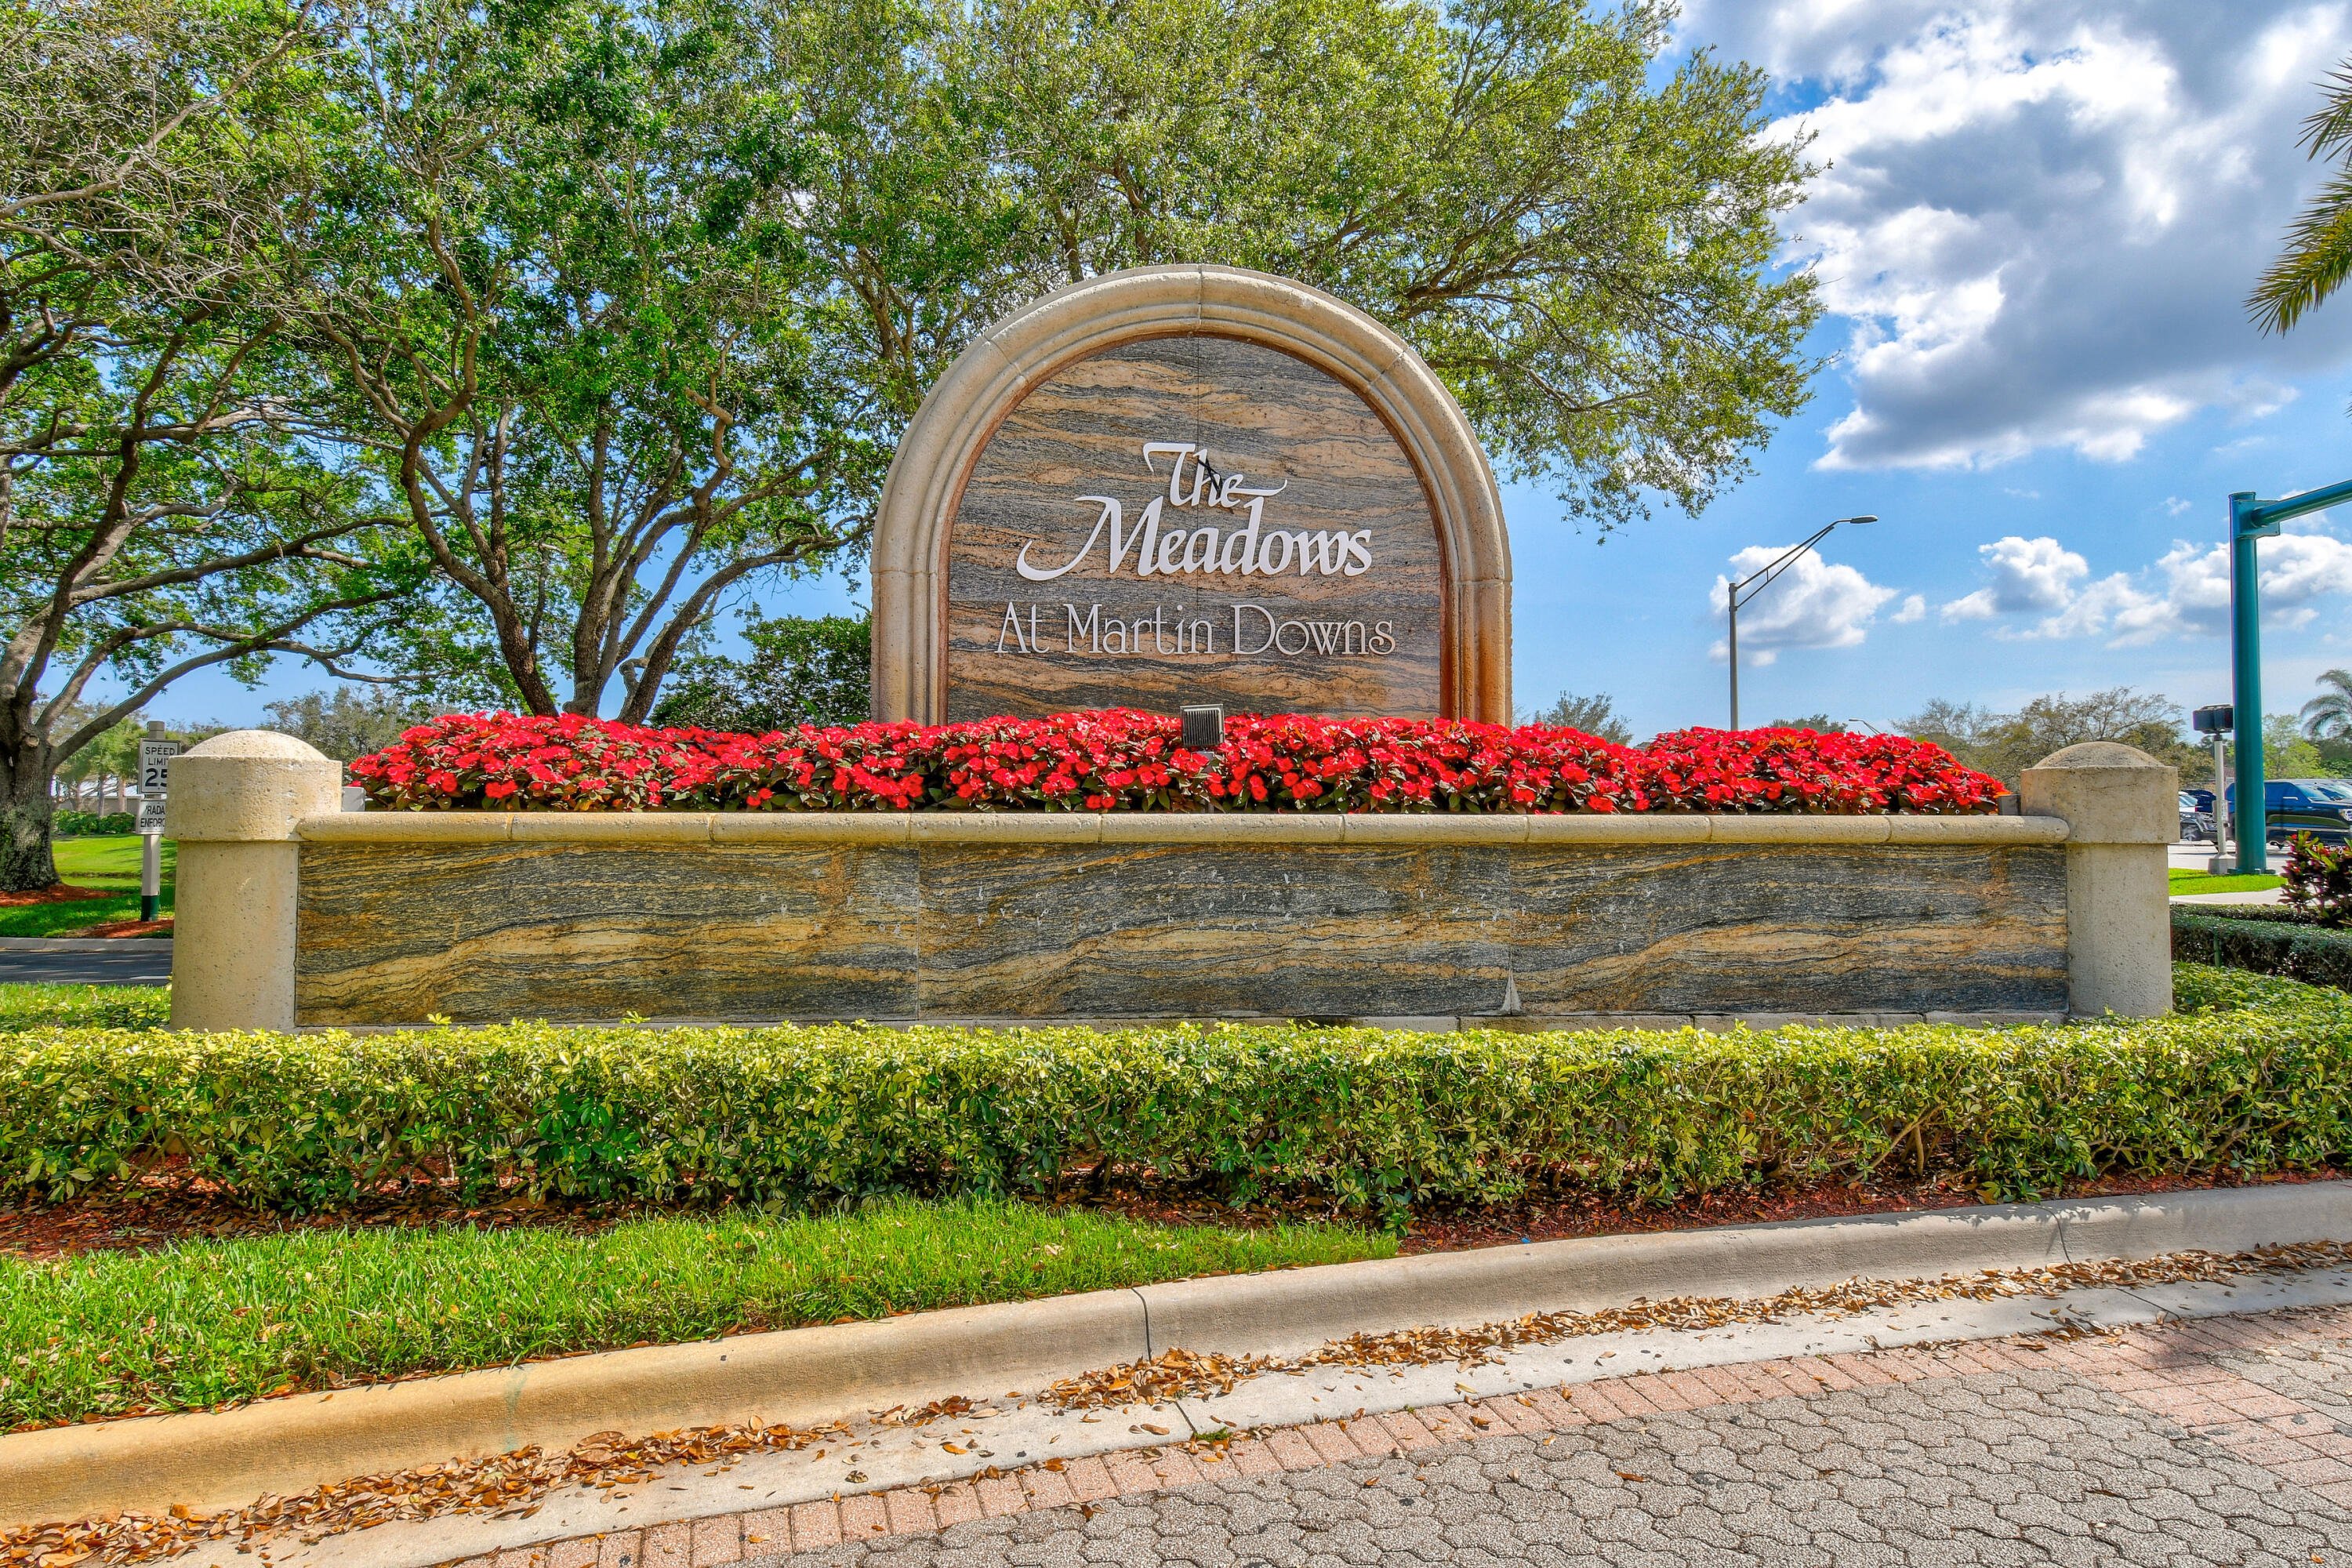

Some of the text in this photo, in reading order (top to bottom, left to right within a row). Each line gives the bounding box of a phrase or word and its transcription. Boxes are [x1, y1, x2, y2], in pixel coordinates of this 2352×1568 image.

[1144, 442, 1287, 507] The
[1017, 495, 1373, 581] Meadows
[995, 601, 1396, 655] At Martin Downs
[147, 805, 165, 814] RADA
